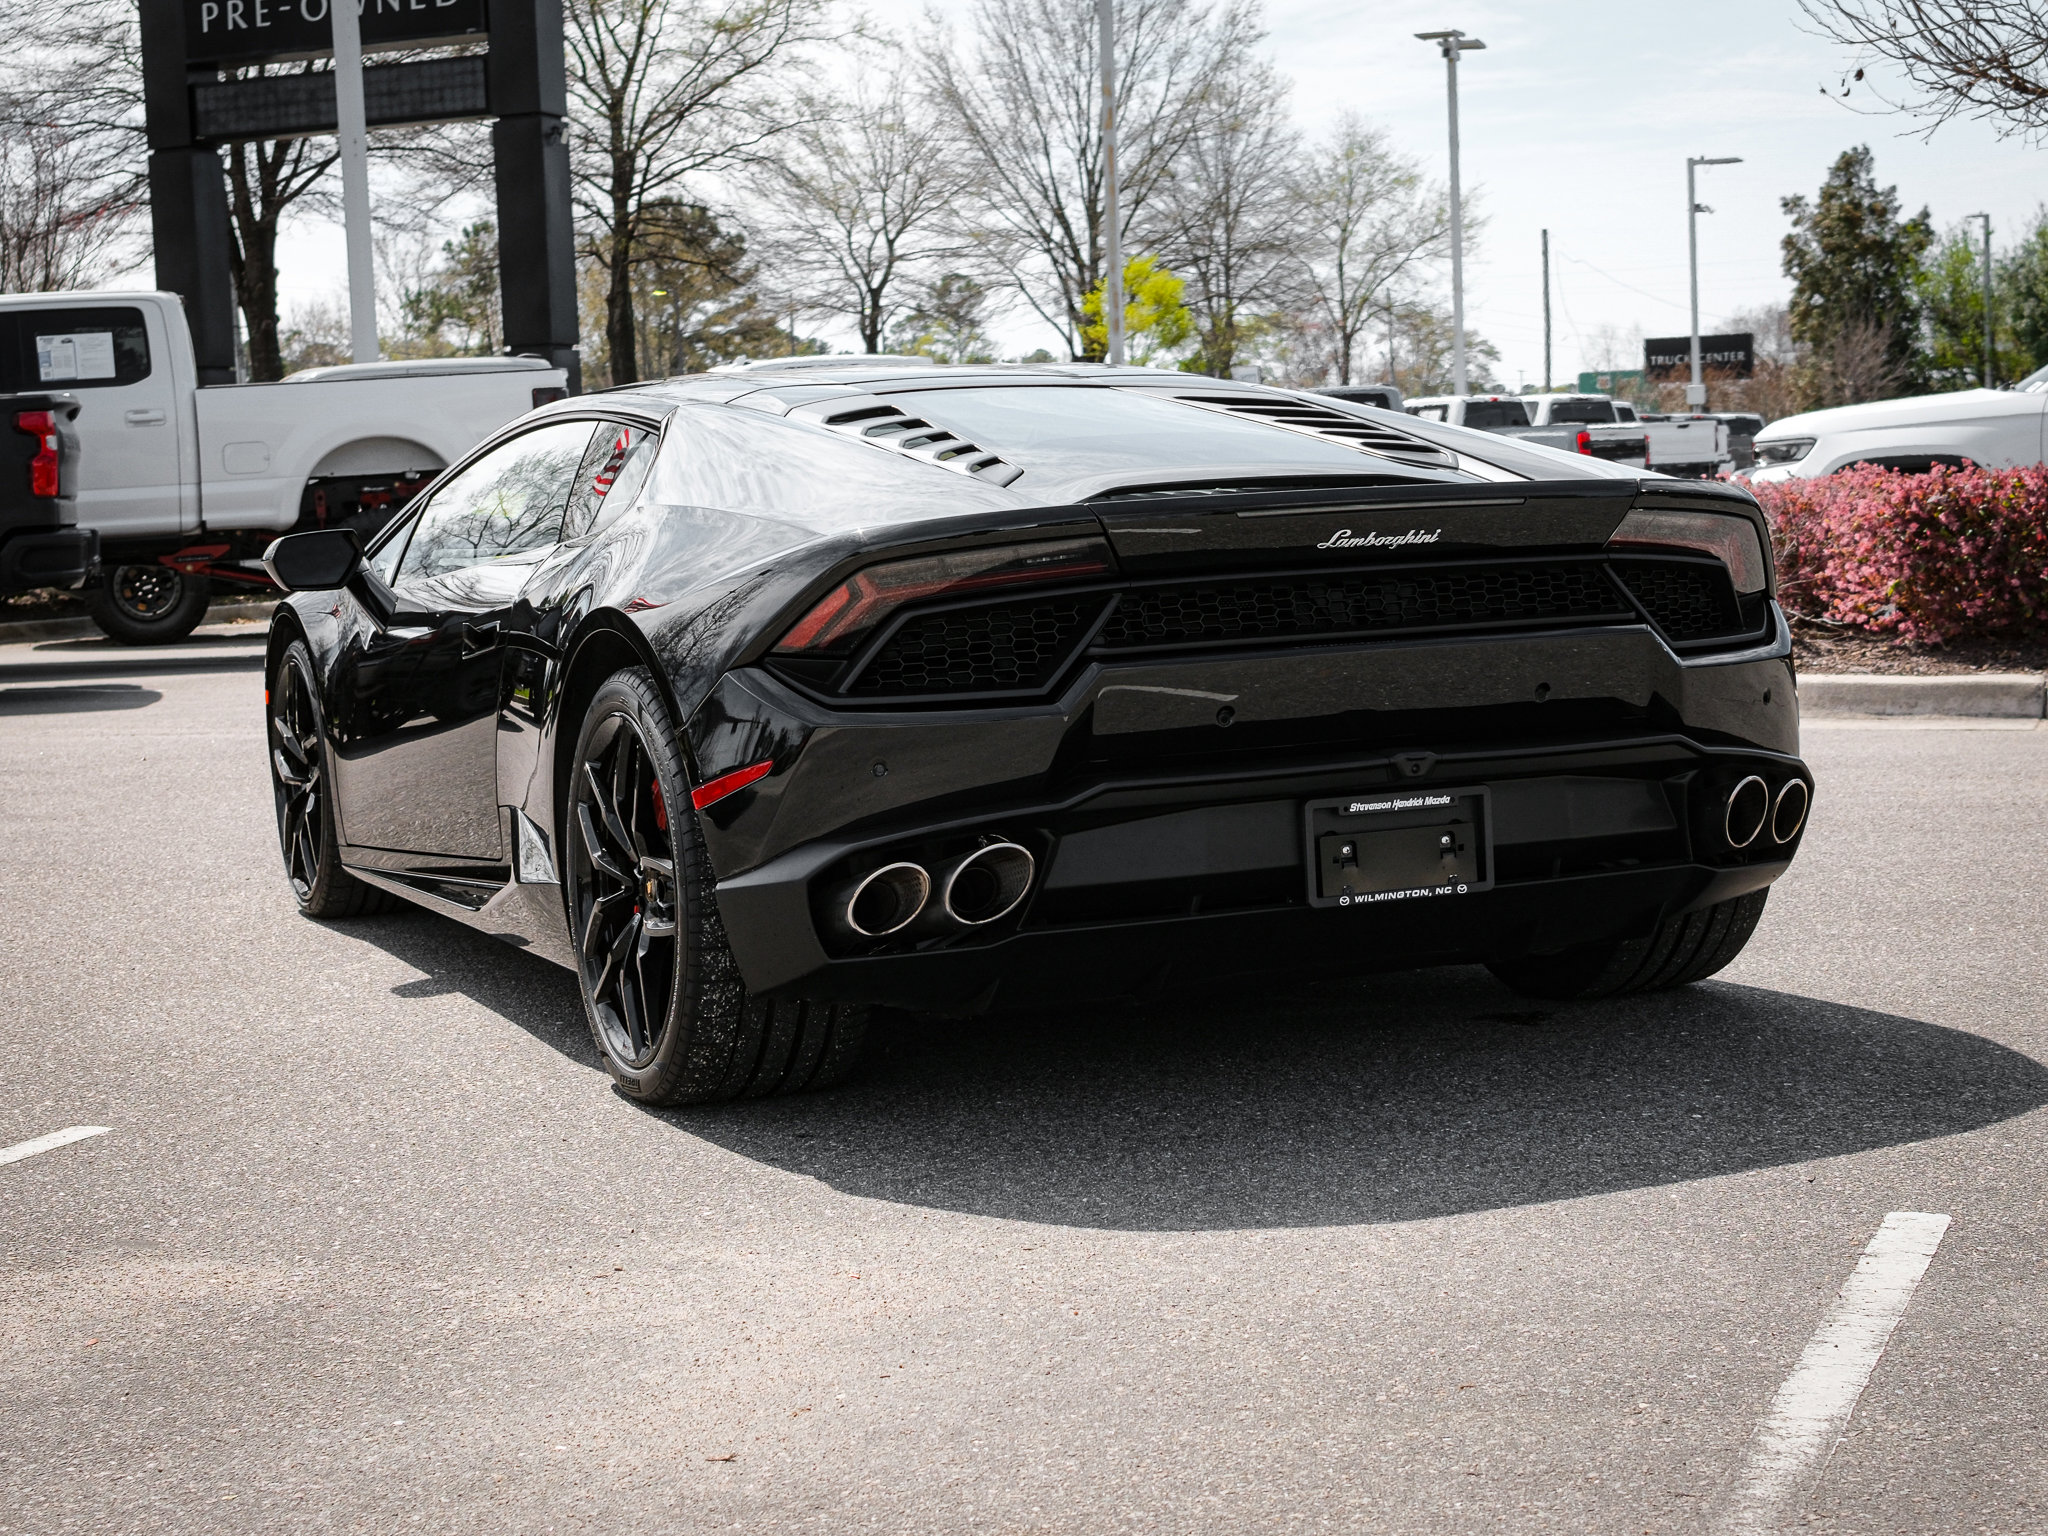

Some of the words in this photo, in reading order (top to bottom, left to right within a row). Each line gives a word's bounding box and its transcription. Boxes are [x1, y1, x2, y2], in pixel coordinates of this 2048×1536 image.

[202, 0, 457, 33] PRE-O
[1649, 354, 1691, 366] TRUCK
[1698, 351, 1745, 364] CENTER
[1316, 528, 1442, 549] Lamborghini
[1349, 802, 1392, 812] Stevenson
[1392, 798, 1424, 811] Hendrick
[1424, 795, 1451, 806] Mazda
[1354, 888, 1432, 903] WILMINGTON,
[1435, 886, 1452, 895] NC
